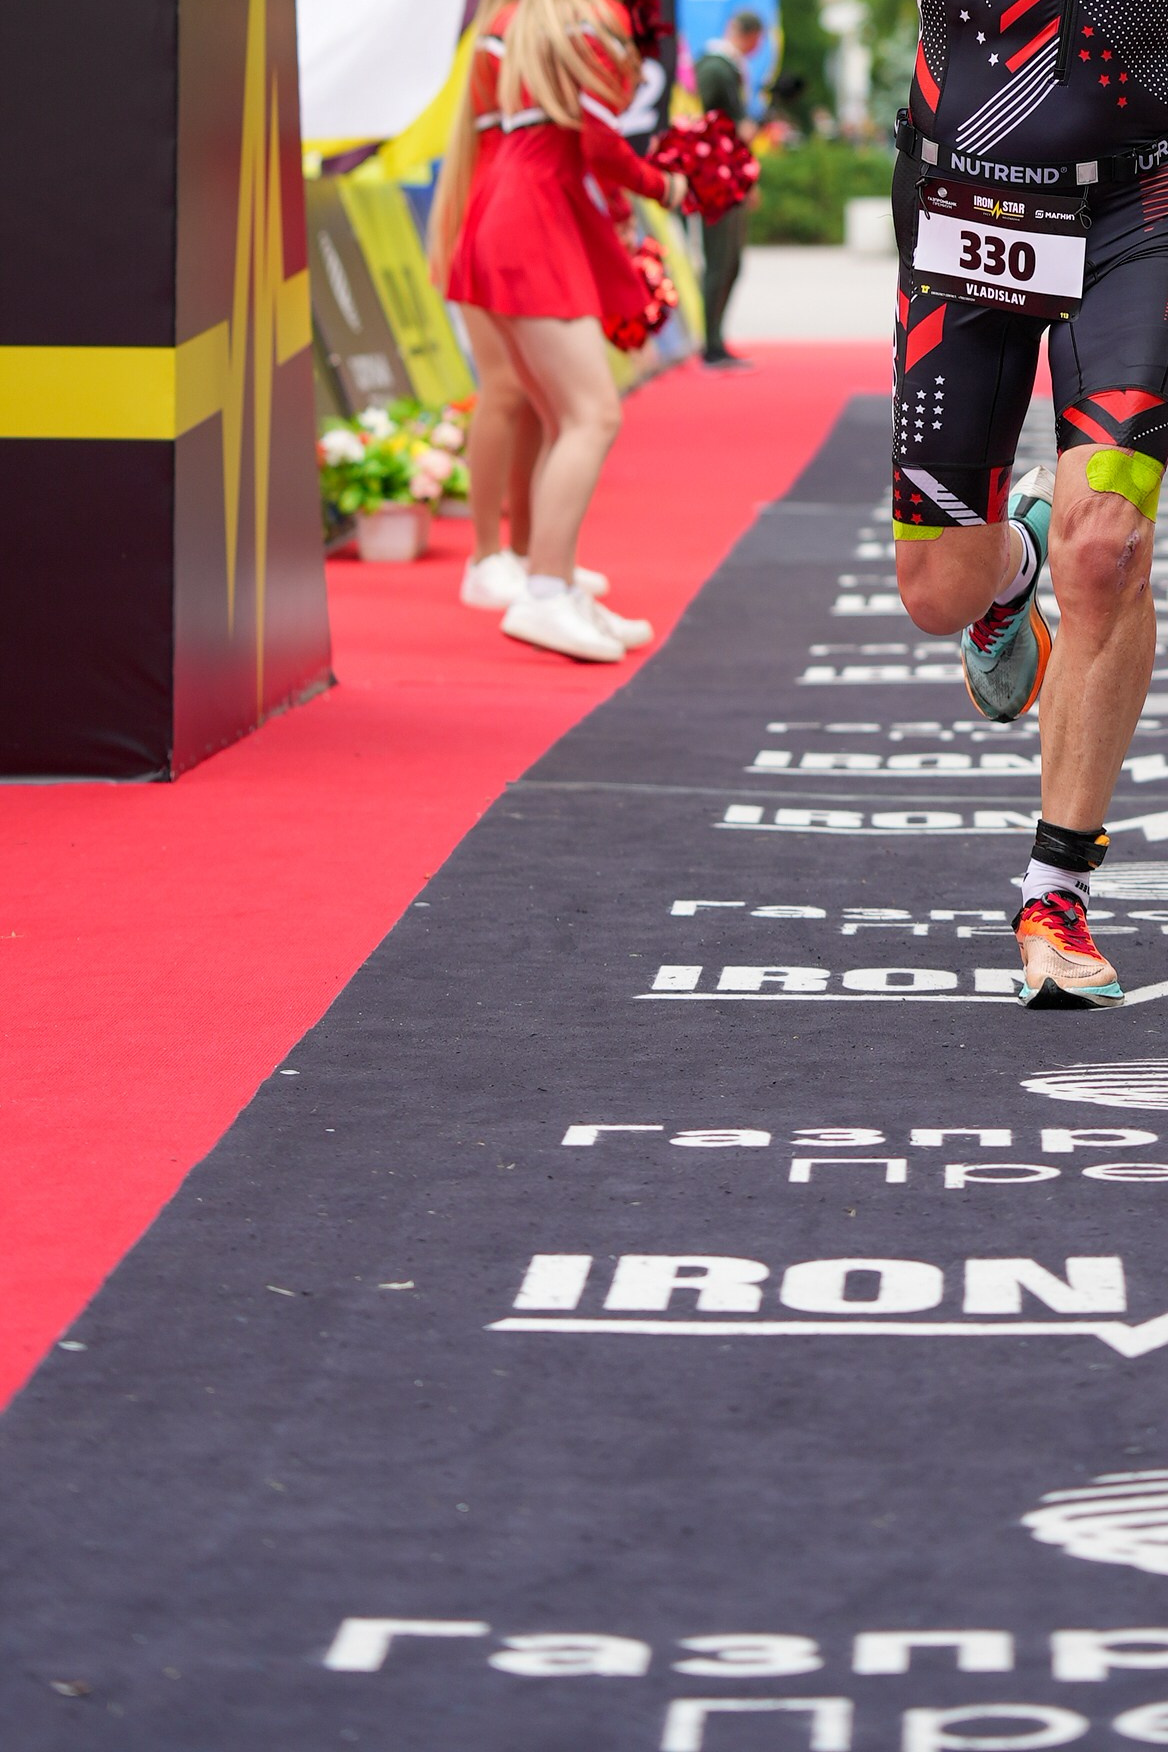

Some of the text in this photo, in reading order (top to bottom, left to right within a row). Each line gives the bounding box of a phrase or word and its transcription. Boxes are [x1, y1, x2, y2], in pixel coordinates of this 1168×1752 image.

[973, 195, 994, 209] IRON
[1002, 201, 1025, 214] STAR
[959, 230, 1036, 282] 330
[965, 283, 1027, 306] VLADISLAV
[513, 1254, 1127, 1314] IRON
